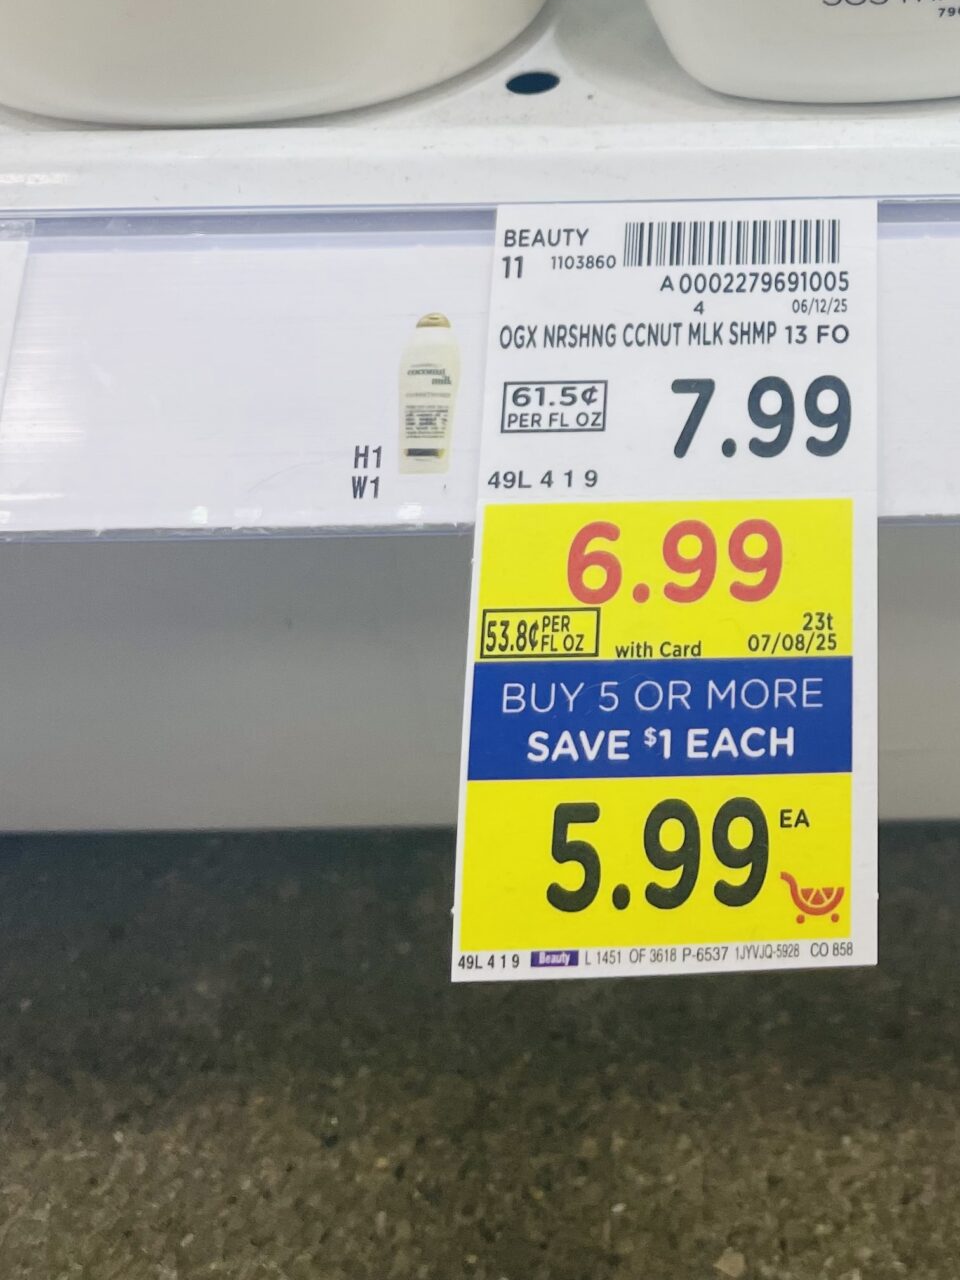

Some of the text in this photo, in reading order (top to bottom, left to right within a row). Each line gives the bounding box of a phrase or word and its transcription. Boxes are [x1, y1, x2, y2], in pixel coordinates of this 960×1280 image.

[504, 228, 589, 248] BEAUTY
[502, 255, 616, 279] 11 1103860
[693, 300, 705, 314] 4
[792, 299, 848, 315] 06/12/25
[499, 321, 850, 349] OGX NRSHNG CCNUT MLK SHMP 13 FO
[511, 385, 598, 407] 61.5¢
[507, 411, 602, 429] PER FL OZ
[671, 374, 852, 459] 7.99
[354, 445, 382, 469] H1
[351, 475, 380, 499] W1
[487, 471, 532, 489] 49L
[567, 518, 783, 605] 6.99
[541, 615, 571, 633] PER
[802, 612, 833, 631] 23t
[486, 619, 538, 652] 53.8¢
[541, 634, 585, 652] FL OZ
[748, 633, 837, 654] 07/08/25
[615, 640, 702, 658] with Card
[502, 677, 824, 714] BUY 5 OR MORE
[527, 726, 795, 762] SAVE $1 EACH
[779, 809, 810, 828] EA
[546, 796, 770, 913] 5.99
[458, 955, 483, 970] 49L
[597, 950, 621, 965] 1451
[629, 948, 646, 964] OF
[650, 948, 676, 963] 3618
[682, 946, 728, 962] P-6537
[810, 942, 829, 957] CO
[832, 941, 853, 957] 858
